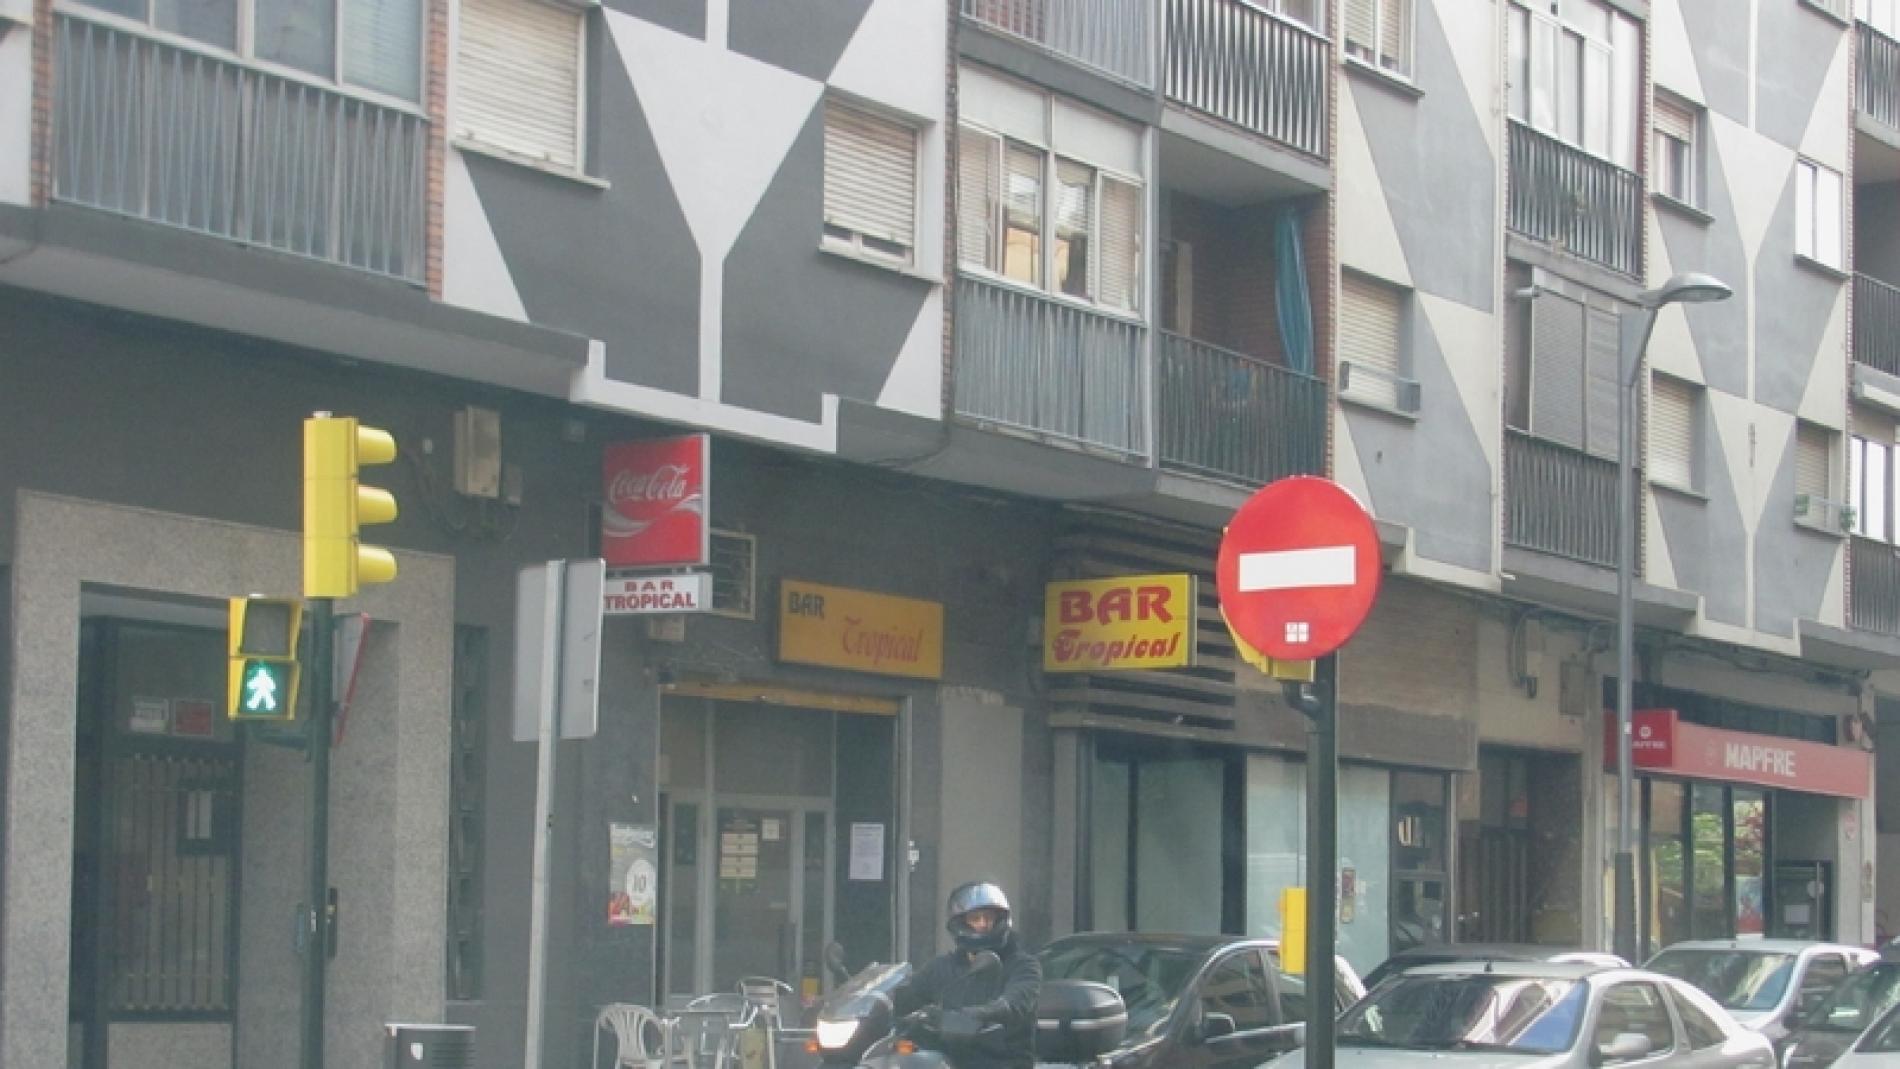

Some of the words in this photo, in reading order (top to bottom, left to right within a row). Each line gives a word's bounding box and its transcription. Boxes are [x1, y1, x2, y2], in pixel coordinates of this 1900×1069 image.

[605, 592, 697, 609] TROPICAL
[624, 580, 673, 592] BAR
[789, 591, 825, 619] BAR
[1060, 586, 1174, 625] BAR
[842, 615, 924, 665] Tropical
[1053, 629, 1182, 665] Tropical
[1724, 743, 1797, 778] MAPFRE
